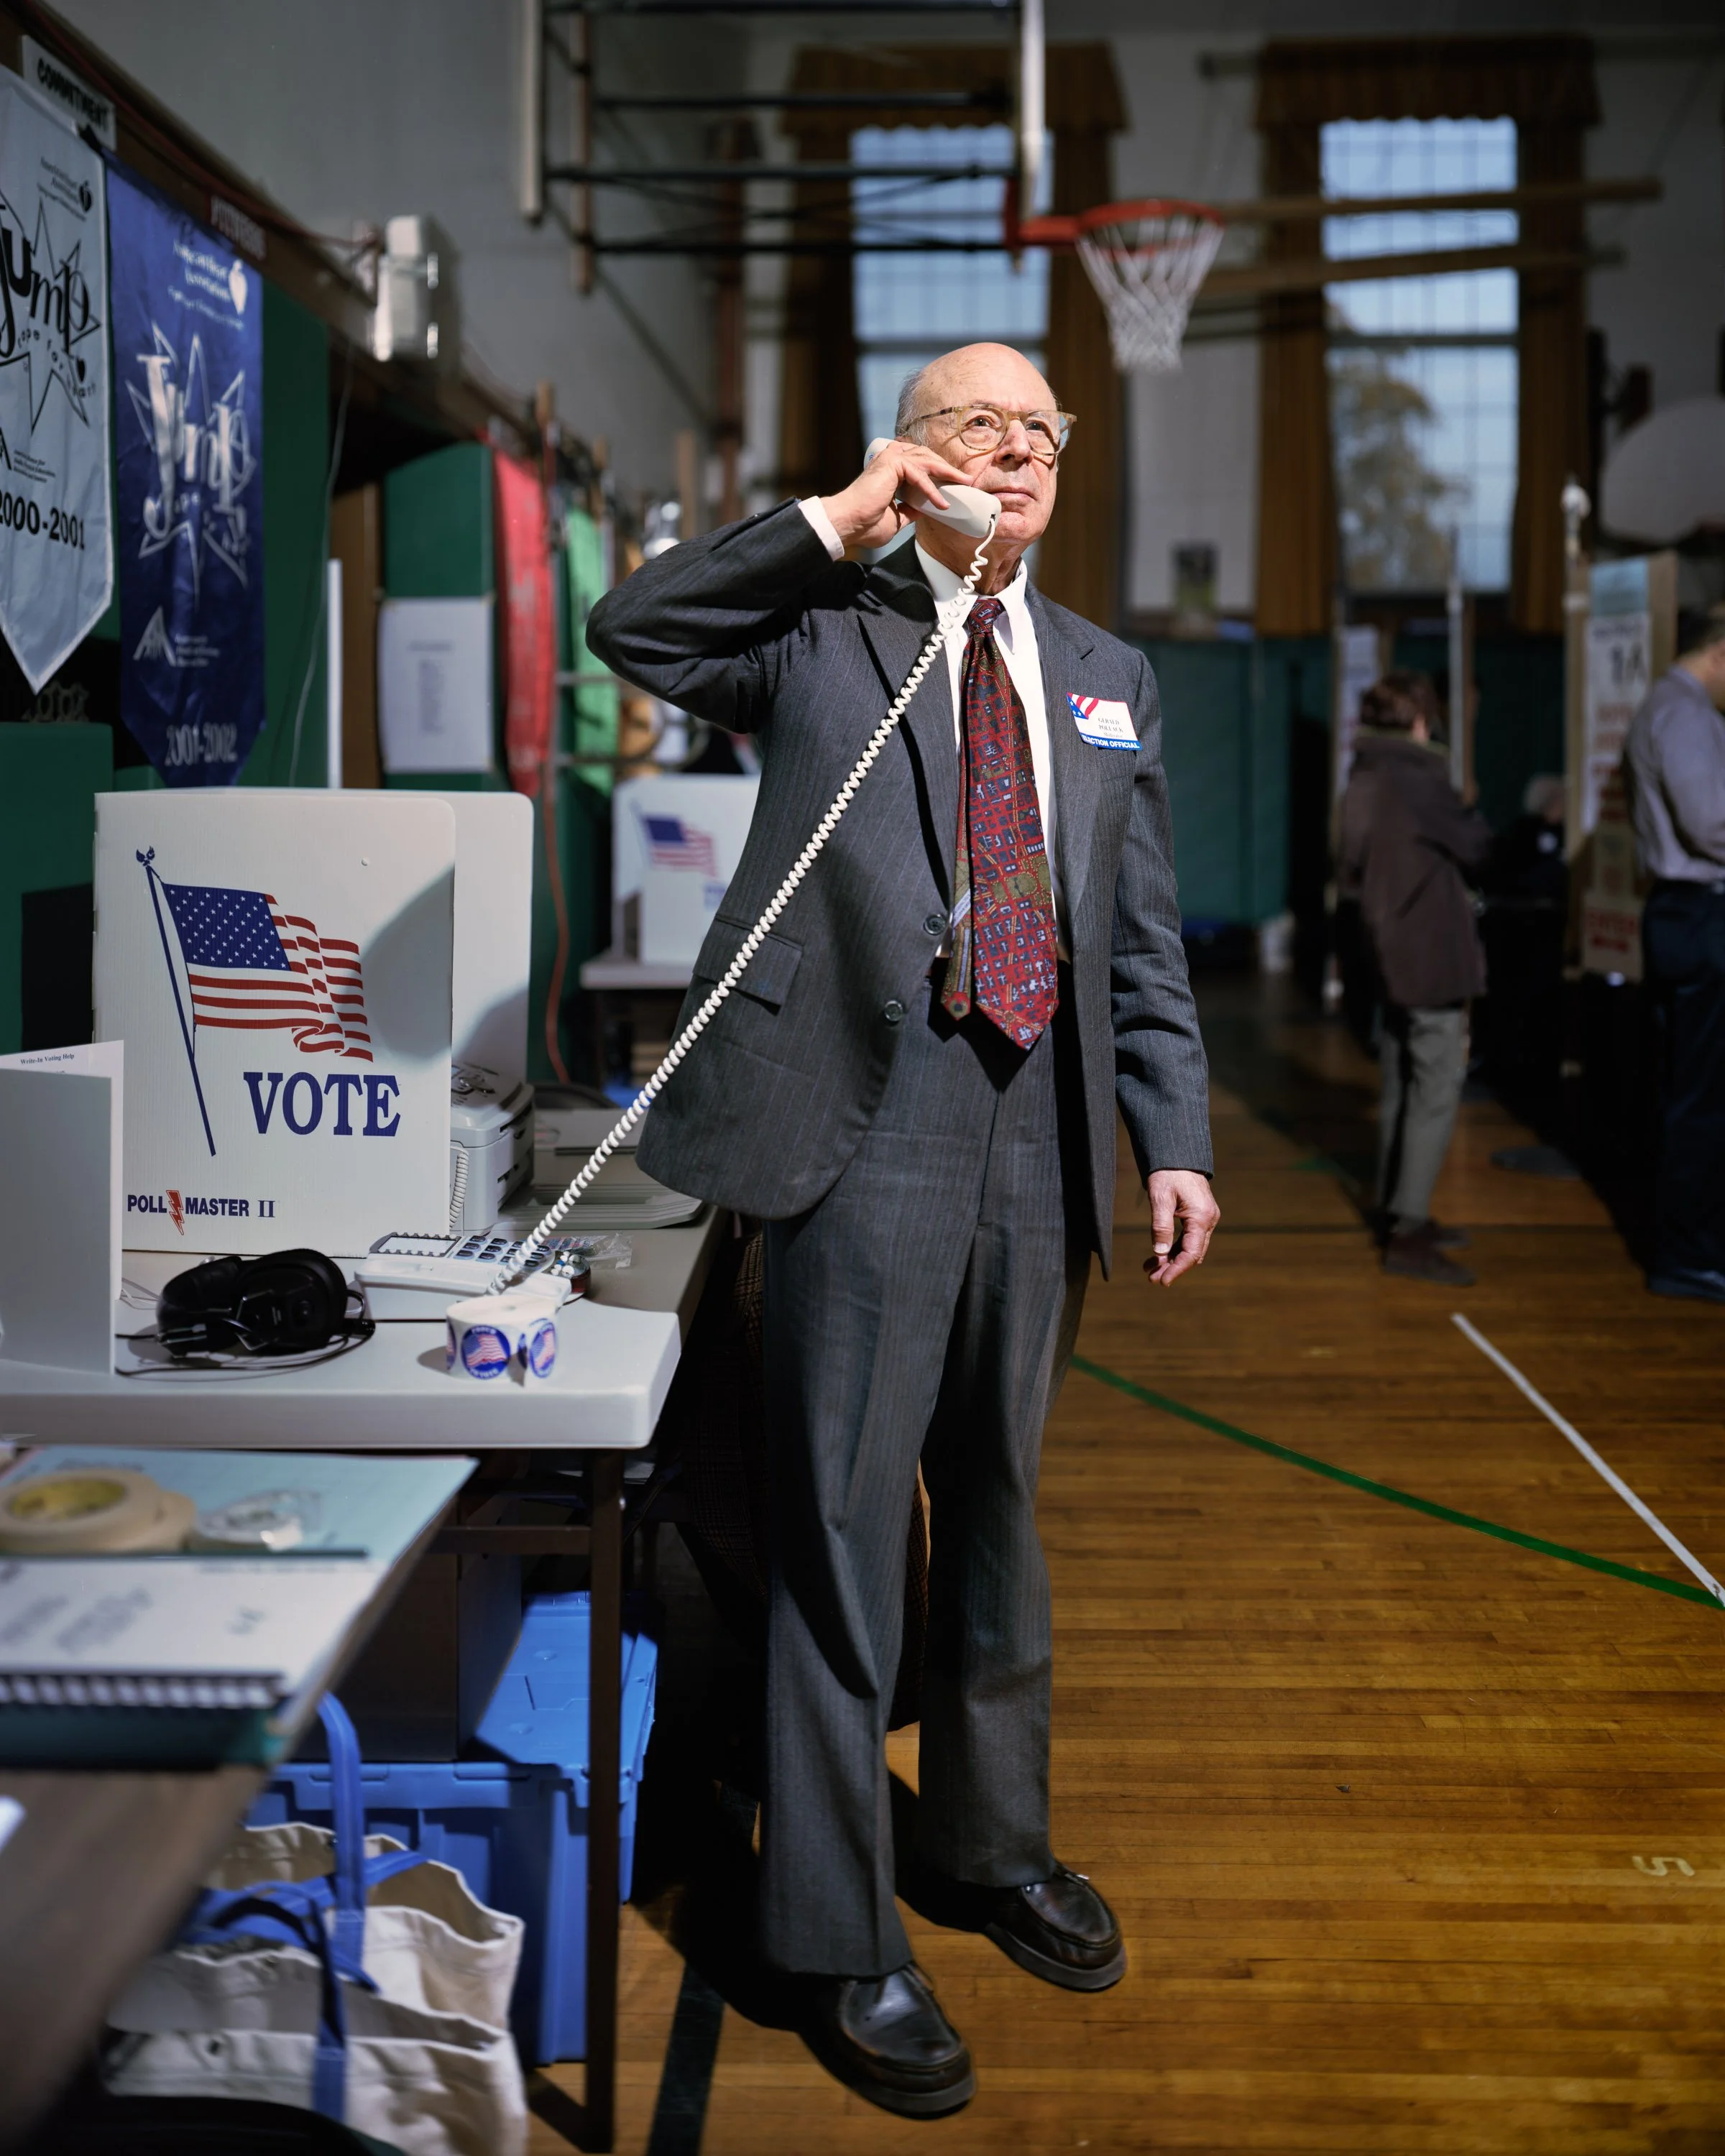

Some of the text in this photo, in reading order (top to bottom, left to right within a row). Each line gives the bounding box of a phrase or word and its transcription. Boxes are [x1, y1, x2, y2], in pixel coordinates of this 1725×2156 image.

[165, 722, 238, 767] 2001-2002
[1081, 734, 1109, 747] ELECTION
[1109, 740, 1140, 749] OFFICIAL
[244, 1072, 401, 1137] VOTE
[127, 1194, 167, 1213] POLL
[185, 1197, 249, 1216] MASTER
